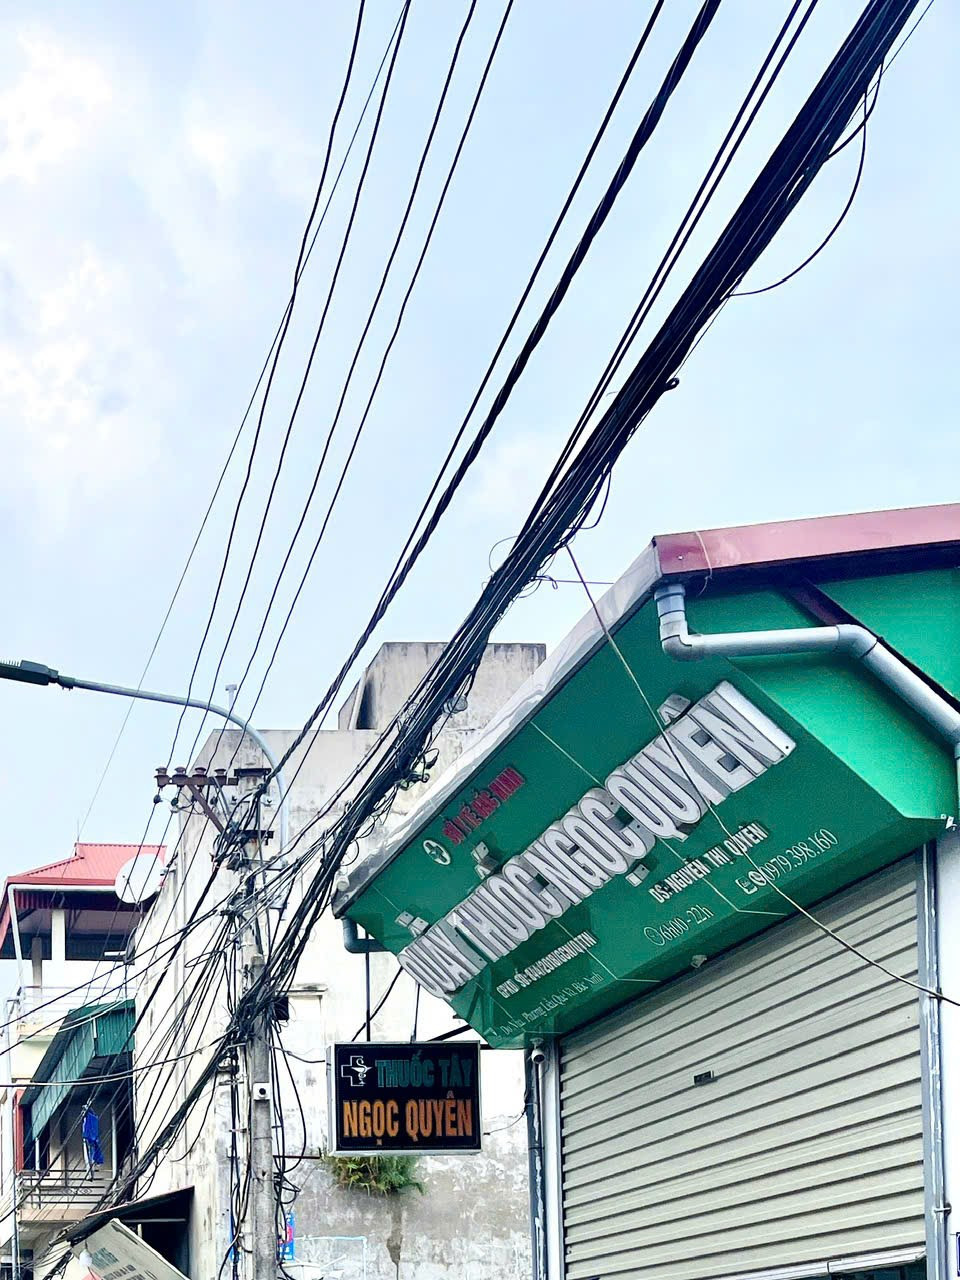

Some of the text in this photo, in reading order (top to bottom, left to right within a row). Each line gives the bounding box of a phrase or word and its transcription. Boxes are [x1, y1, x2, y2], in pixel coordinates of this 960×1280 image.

[604, 680, 797, 842] QUYÊN
[759, 828, 839, 883] 0979.398.160
[374, 1049, 473, 1088] THUỐC TÂY
[342, 1090, 473, 1146] NGỌC QUYÊN
